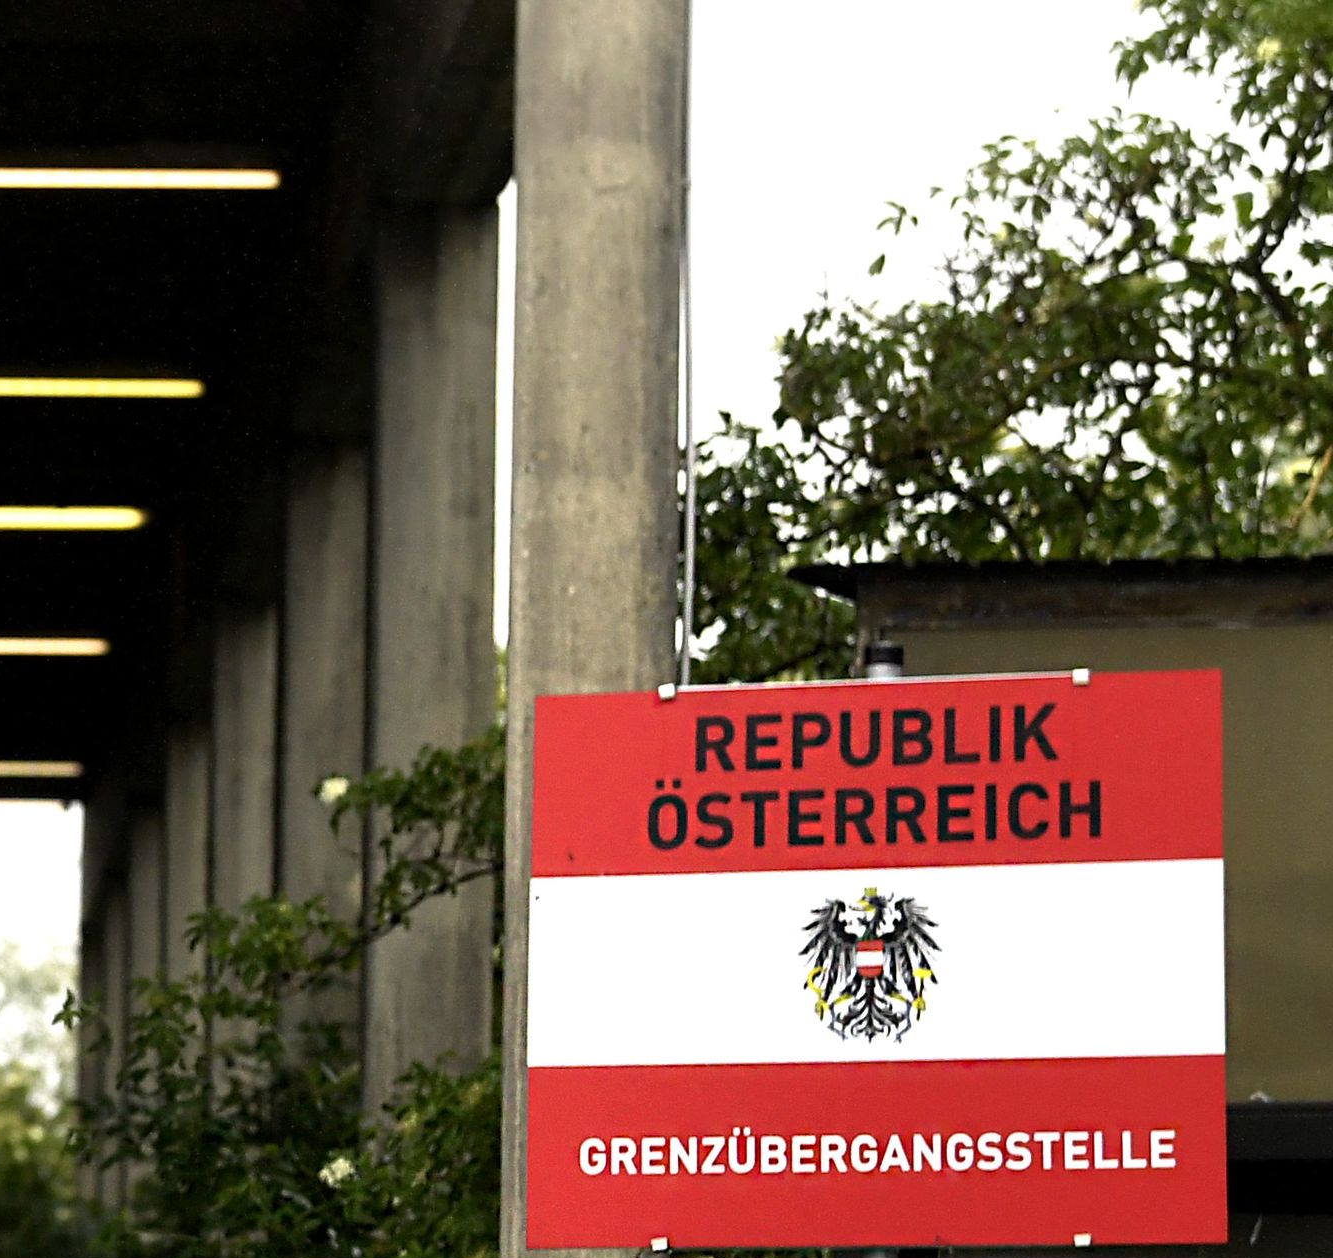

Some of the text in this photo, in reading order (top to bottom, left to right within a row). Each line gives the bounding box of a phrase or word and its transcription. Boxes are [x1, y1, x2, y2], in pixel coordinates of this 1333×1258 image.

[694, 703, 1058, 772] REPUBLIK
[646, 779, 1103, 850] ÖSTERREICH
[578, 1127, 1177, 1176] GRENZÜBERGANGSSTELLE
